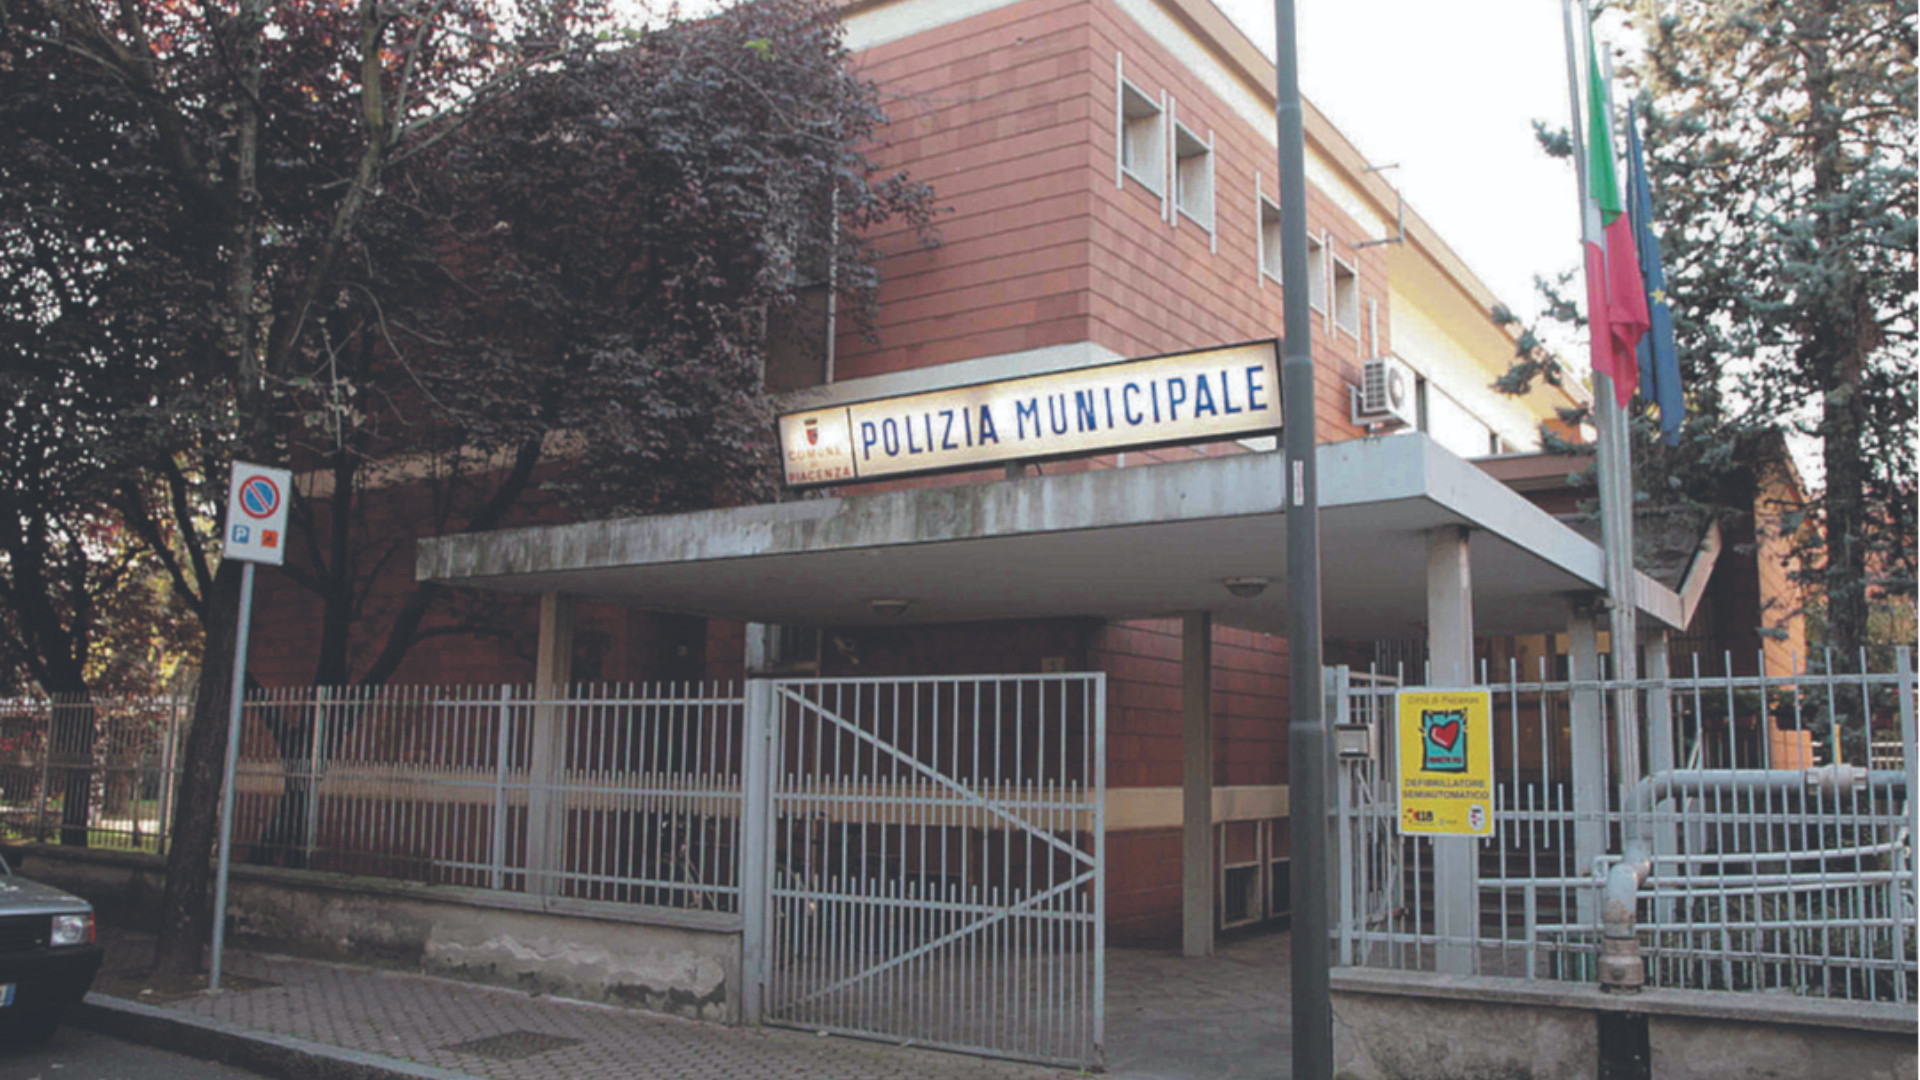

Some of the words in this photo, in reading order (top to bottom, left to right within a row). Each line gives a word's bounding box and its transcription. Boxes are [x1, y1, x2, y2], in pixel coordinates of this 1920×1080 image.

[861, 404, 1000, 461] POLIZIA
[1016, 365, 1269, 440] MUNICIPALE
[788, 466, 851, 482] PIACENZA
[235, 526, 246, 542] P
[1405, 779, 1486, 788] DEFIBRILLATORE
[1403, 790, 1489, 800] SEMIAUTOMATICO
